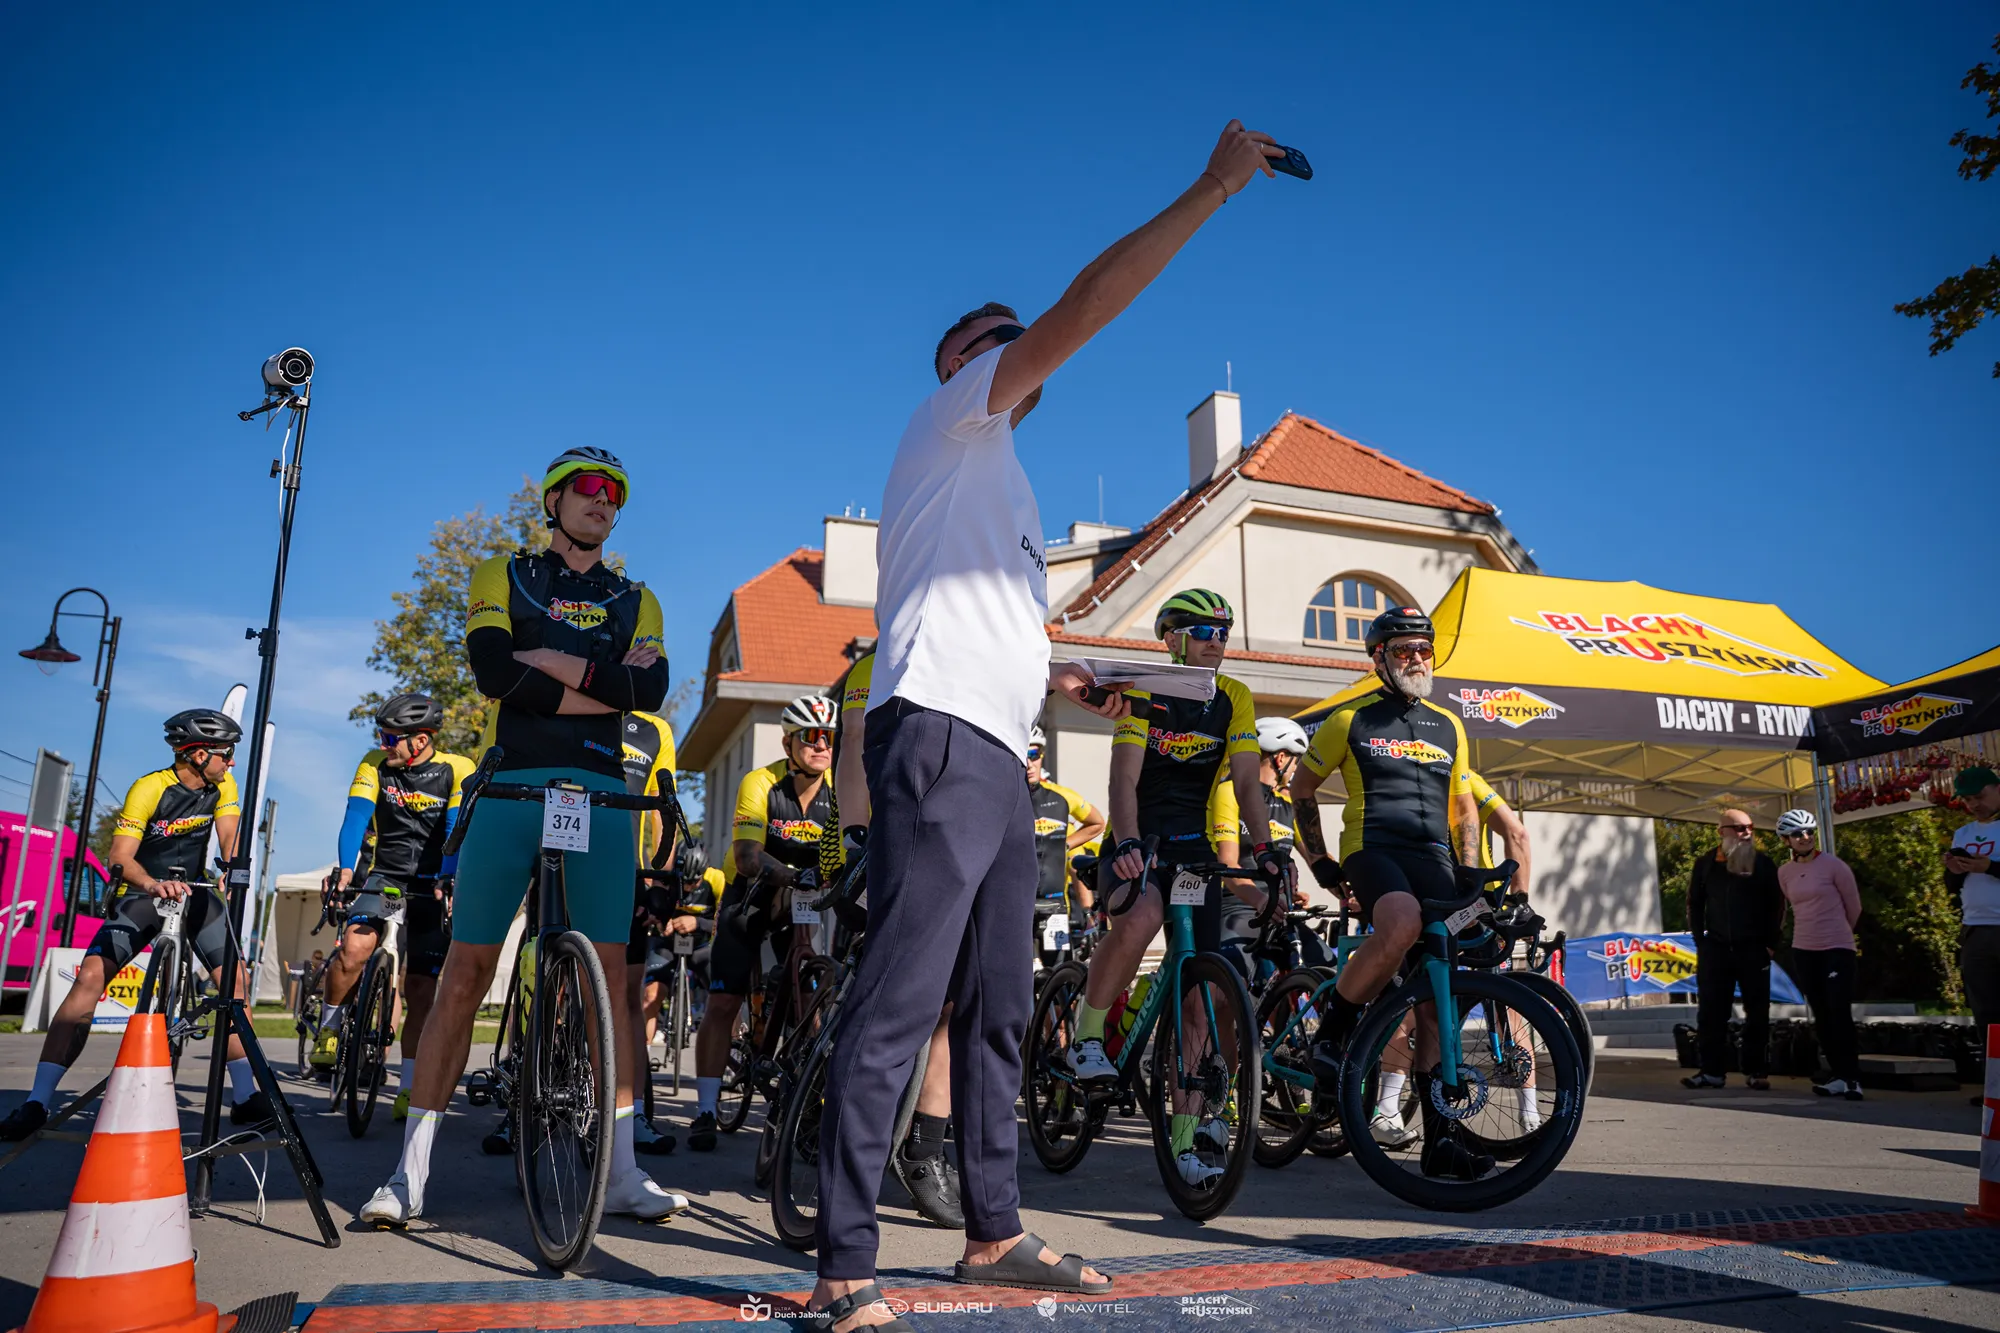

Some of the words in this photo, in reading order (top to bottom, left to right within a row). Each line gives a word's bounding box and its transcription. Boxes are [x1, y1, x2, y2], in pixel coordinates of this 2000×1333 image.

[1542, 612, 1709, 641] BLACHY
[1565, 636, 1824, 677] PRUSZYŃSKI
[1461, 690, 1521, 701] BLACHY
[1464, 703, 1557, 720] PRUSZYŃSKI
[1656, 697, 1734, 733] DACHY
[1862, 697, 1924, 721] BLACHY
[1864, 703, 1961, 736] PRUSZYŃSKI
[1149, 728, 1195, 743] BLACHY
[1371, 738, 1424, 749] BLACHY
[553, 814, 580, 832] 374
[772, 819, 813, 829] BLACHY
[1179, 880, 1201, 890] 460
[385, 901, 401, 910] 384
[1459, 910, 1471, 923] 431
